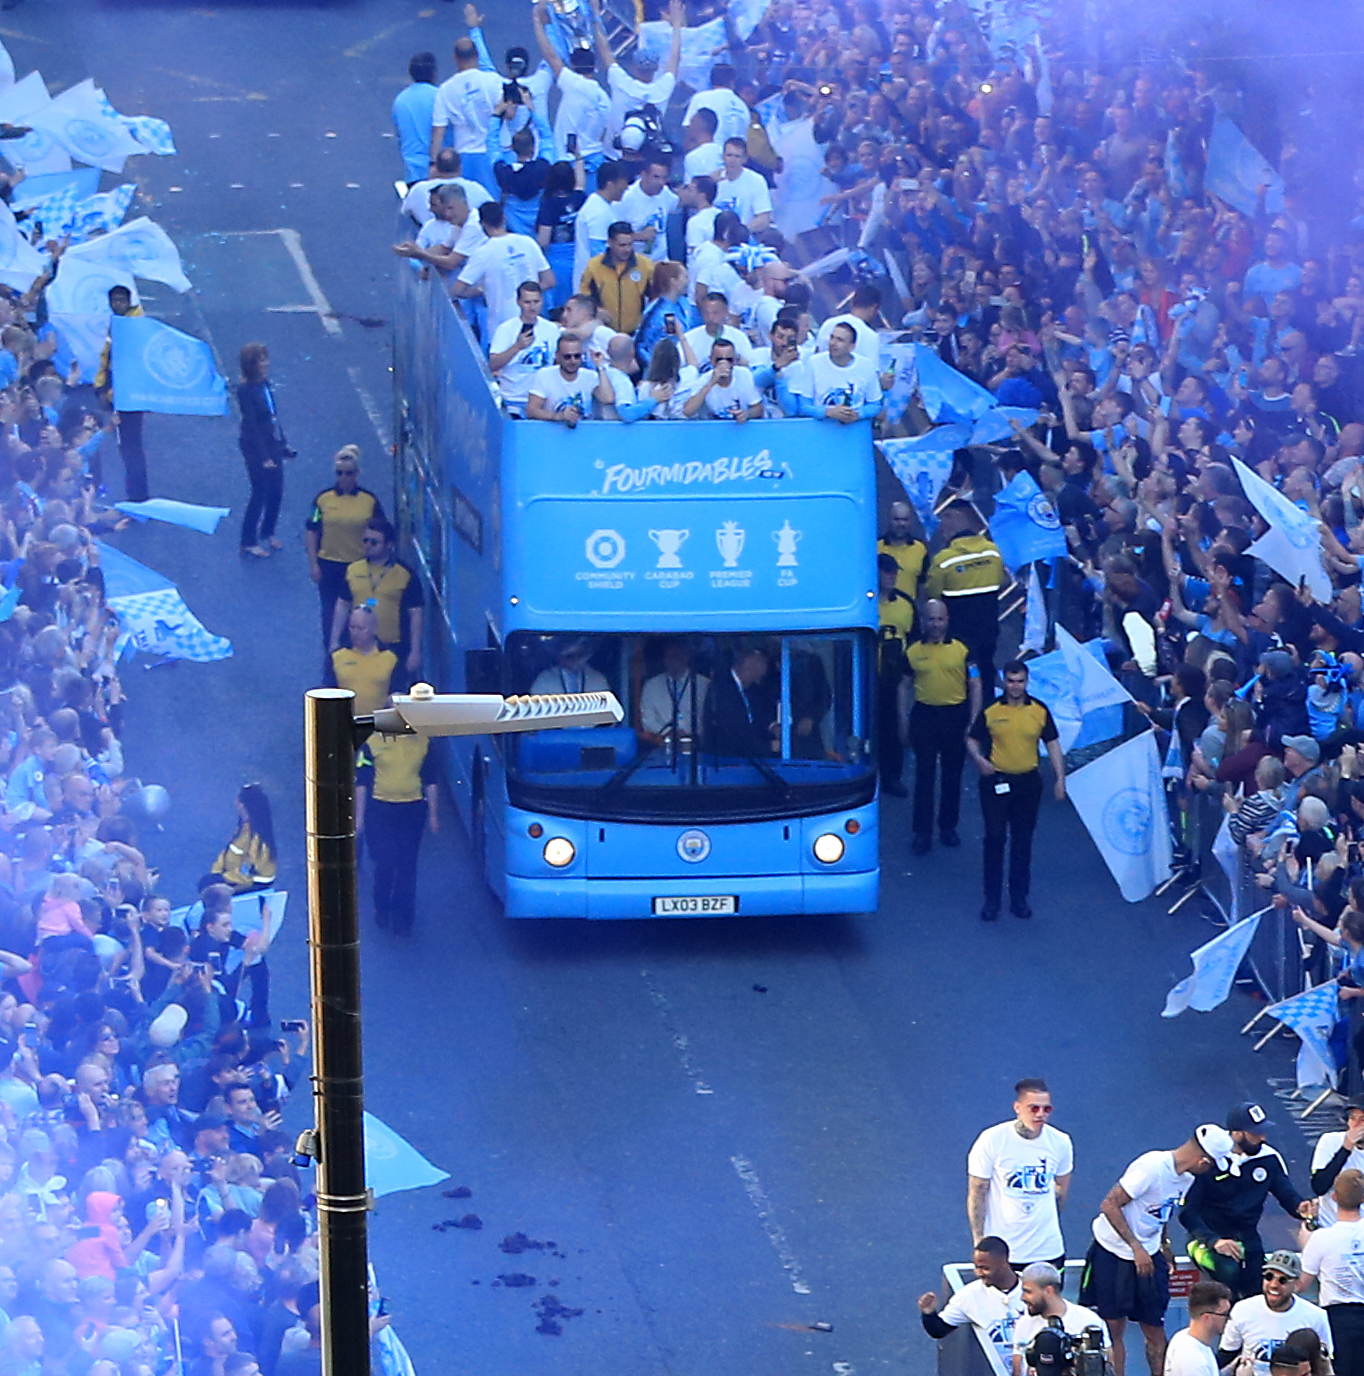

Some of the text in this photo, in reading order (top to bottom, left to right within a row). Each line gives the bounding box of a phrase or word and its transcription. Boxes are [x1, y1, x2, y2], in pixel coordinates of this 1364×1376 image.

[575, 571, 636, 581] COMMUNITY
[709, 570, 753, 579] PREMIER
[780, 569, 793, 578] FA
[587, 580, 624, 589] SHIELD
[658, 580, 681, 588] CUP
[711, 579, 751, 588] LEAGUE
[777, 578, 798, 587] CUP
[662, 898, 727, 911] LX03 BZF
